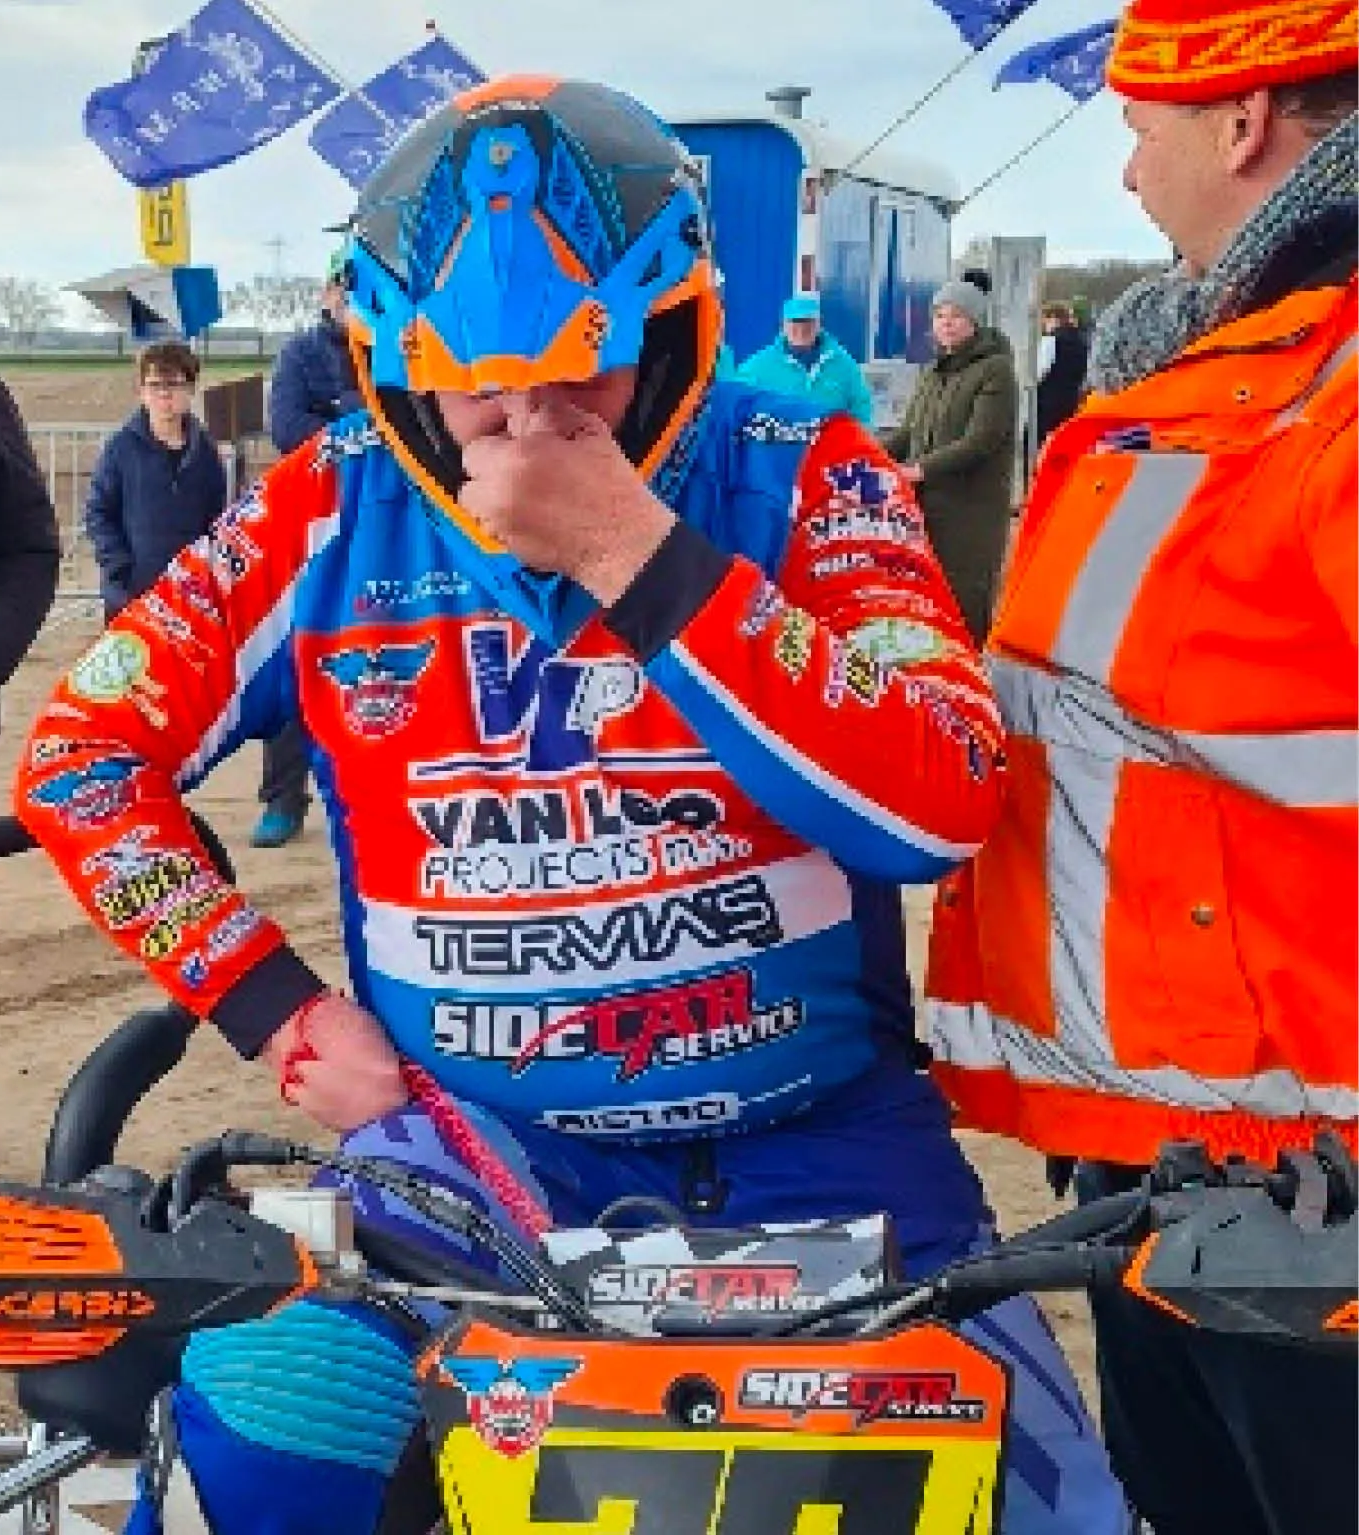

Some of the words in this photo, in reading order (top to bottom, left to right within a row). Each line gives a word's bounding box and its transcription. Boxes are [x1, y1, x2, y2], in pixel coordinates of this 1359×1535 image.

[413, 793, 570, 848] VAN
[425, 838, 650, 893] PROJECTS
[433, 968, 754, 1078] SIDECAR
[660, 999, 804, 1065] SERVICE
[742, 1370, 956, 1418] SIDECAR
